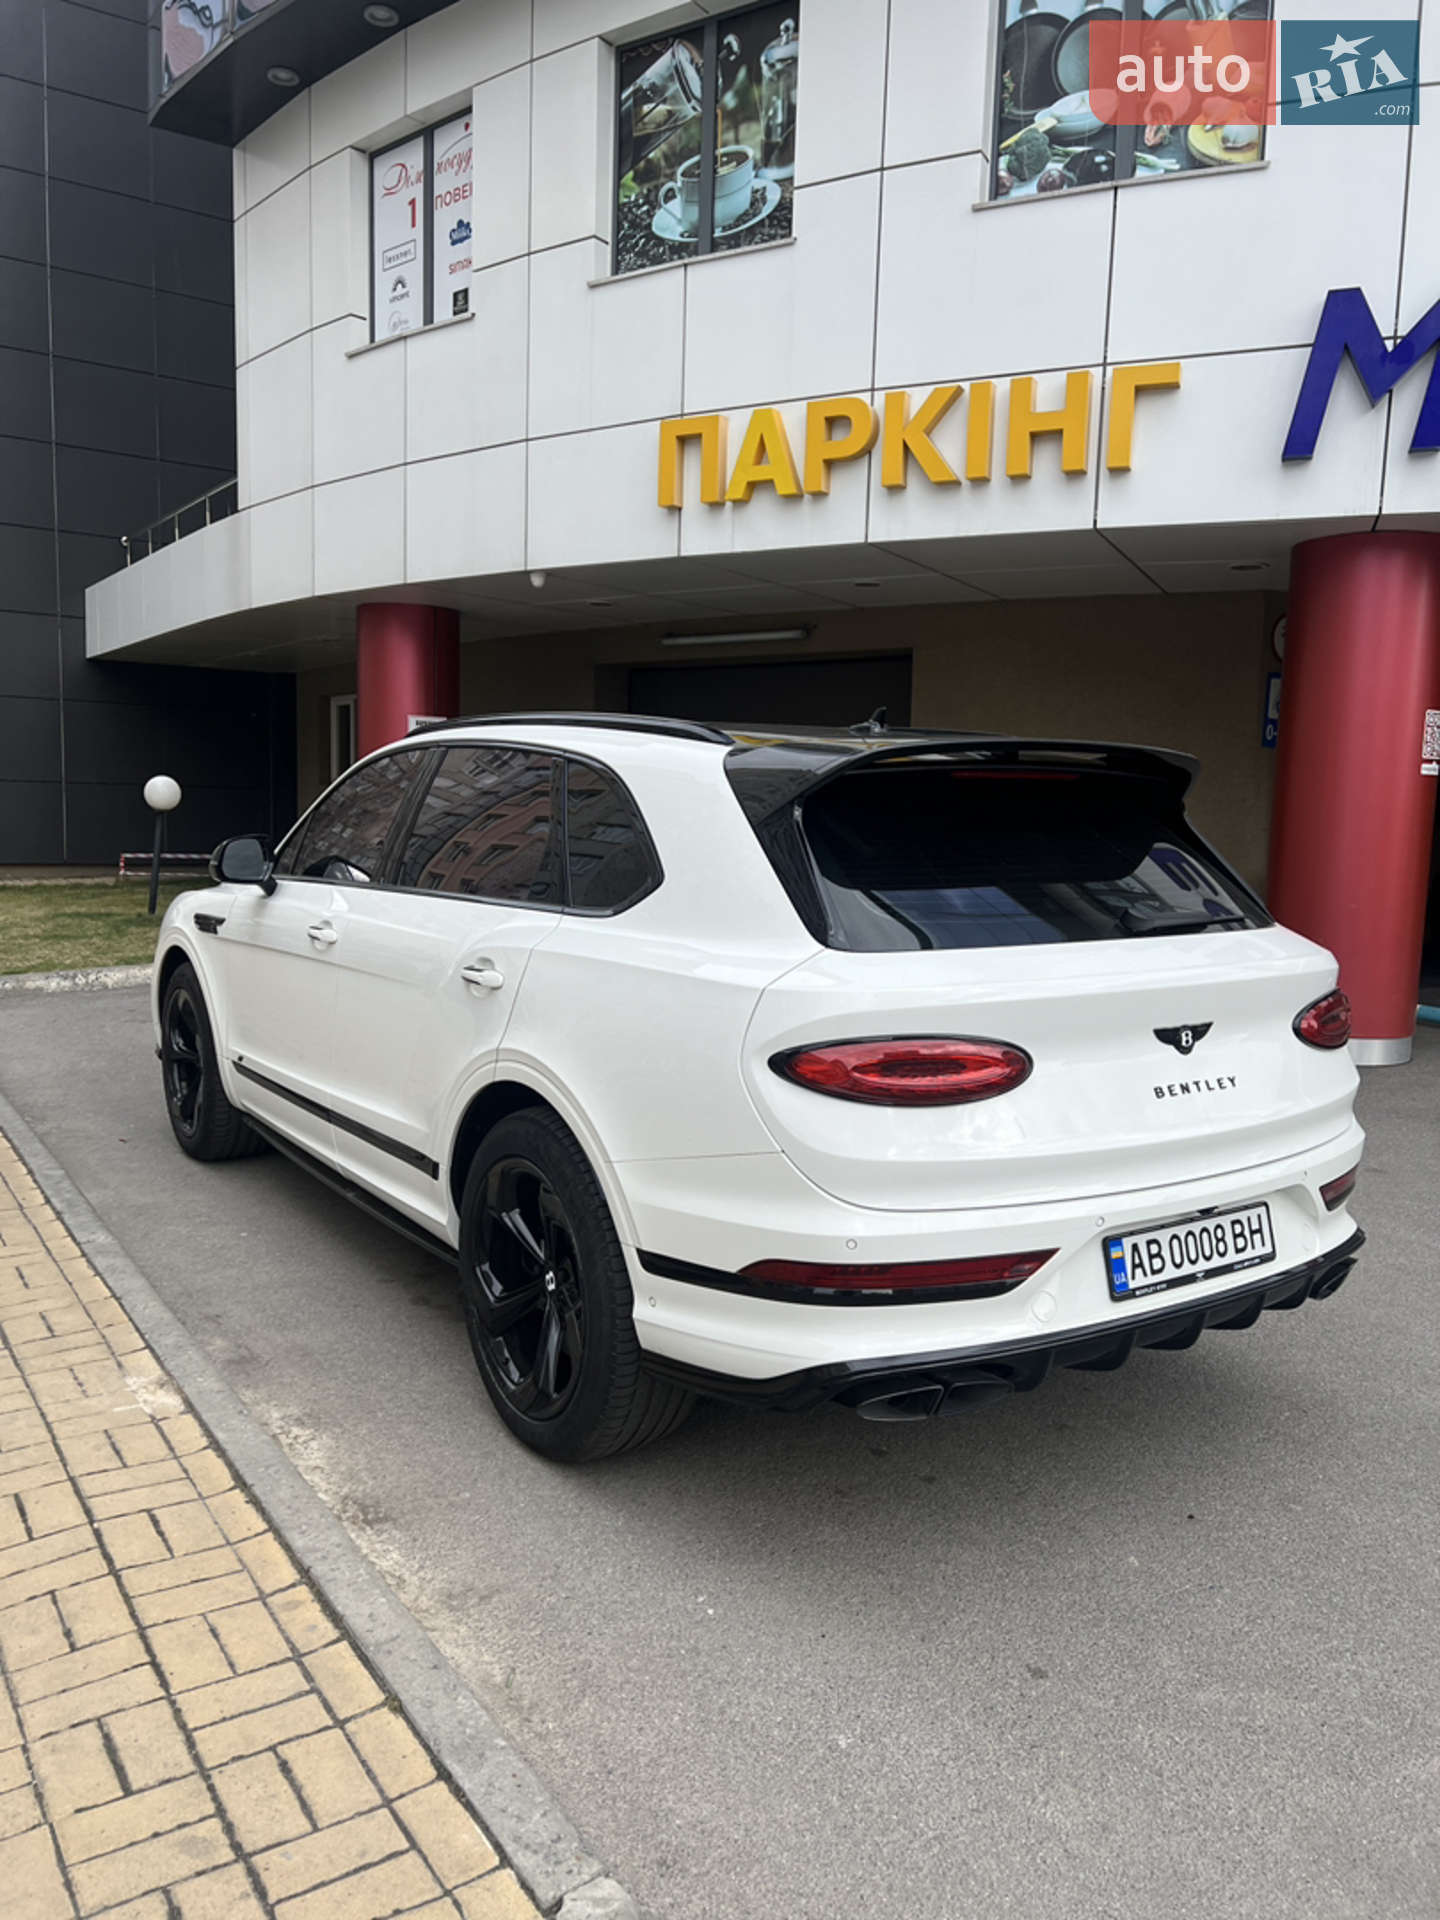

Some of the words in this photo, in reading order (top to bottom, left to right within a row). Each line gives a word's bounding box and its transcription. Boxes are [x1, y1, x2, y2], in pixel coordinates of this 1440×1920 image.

[435, 147, 473, 177] посуд
[408, 197, 417, 229] 1
[657, 361, 1182, 511] ПАРКІНГ
[1153, 1075, 1237, 1100] BENTLEY
[1130, 1238, 1166, 1281] AB
[1168, 1222, 1228, 1270] 0008
[1230, 1213, 1266, 1255] BH
[1114, 1272, 1128, 1286] UA
